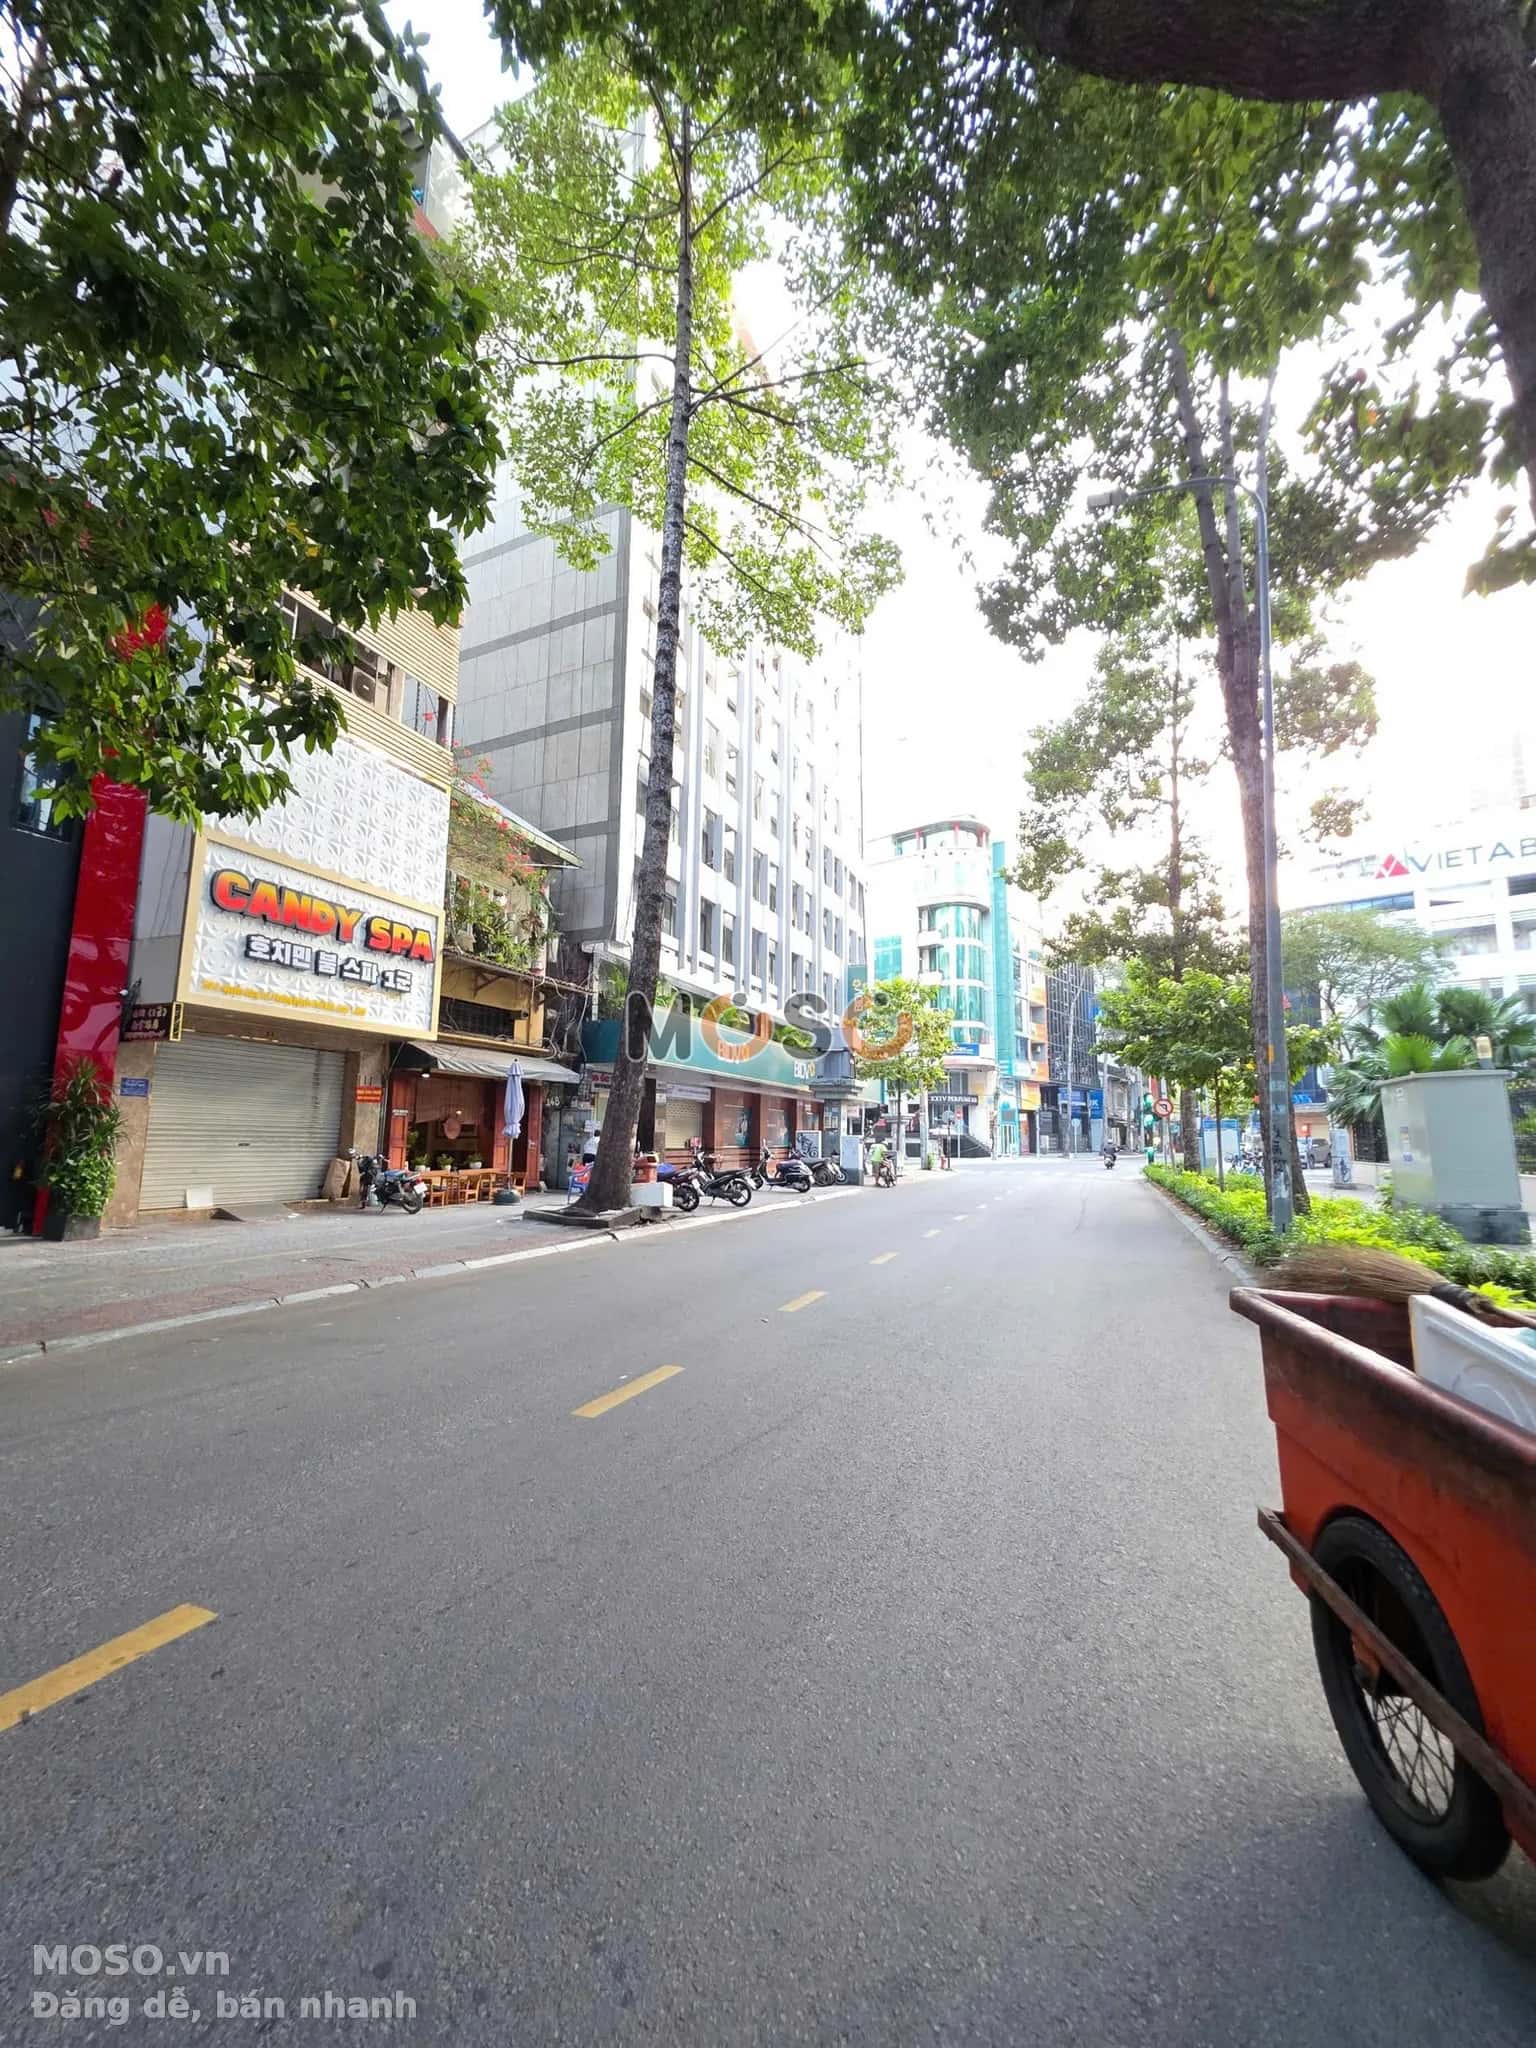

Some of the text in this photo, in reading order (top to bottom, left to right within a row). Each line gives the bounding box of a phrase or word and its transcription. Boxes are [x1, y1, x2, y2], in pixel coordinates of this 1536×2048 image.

[211, 869, 435, 962] CANDY SPA
[246, 934, 314, 971] 호치민
[340, 957, 380, 986] 스파
